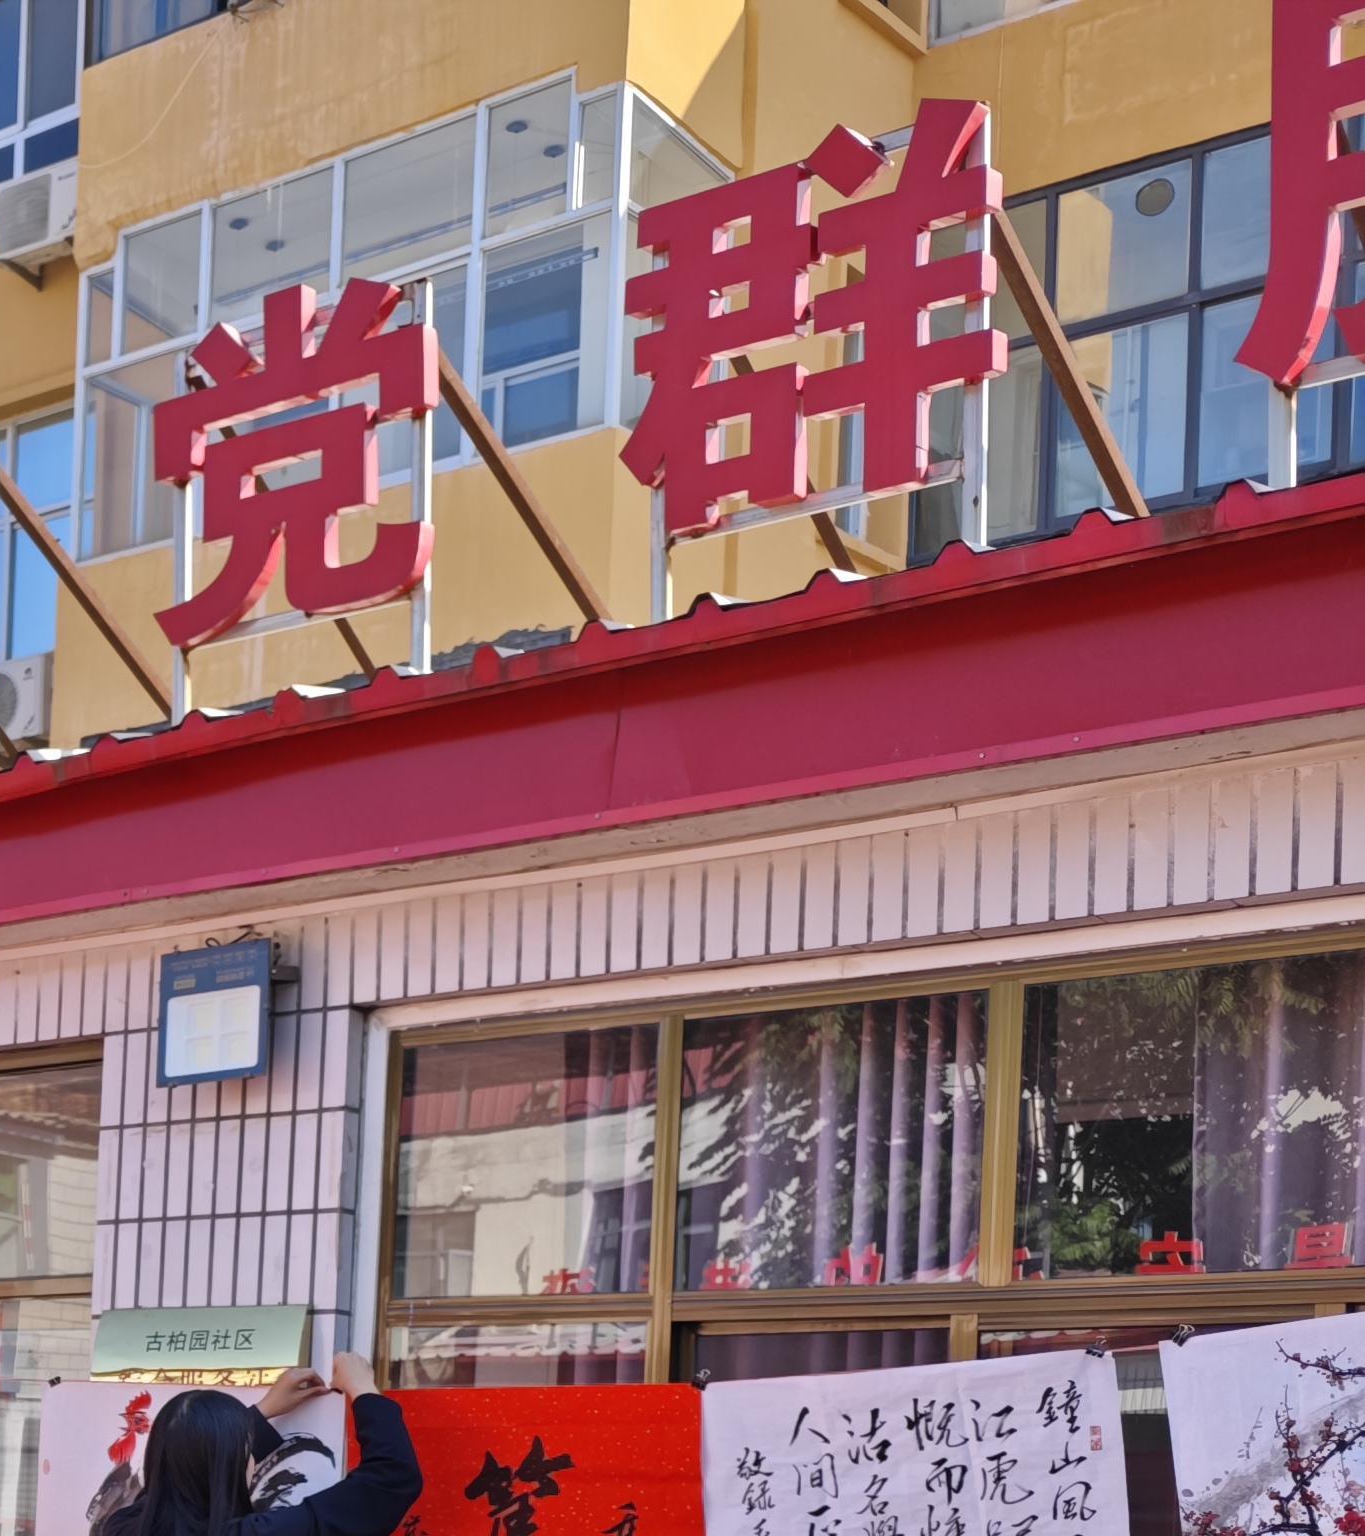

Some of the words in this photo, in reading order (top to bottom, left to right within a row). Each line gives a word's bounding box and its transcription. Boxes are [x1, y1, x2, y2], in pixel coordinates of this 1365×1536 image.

[145, 1328, 257, 1353] 古柏园社区
